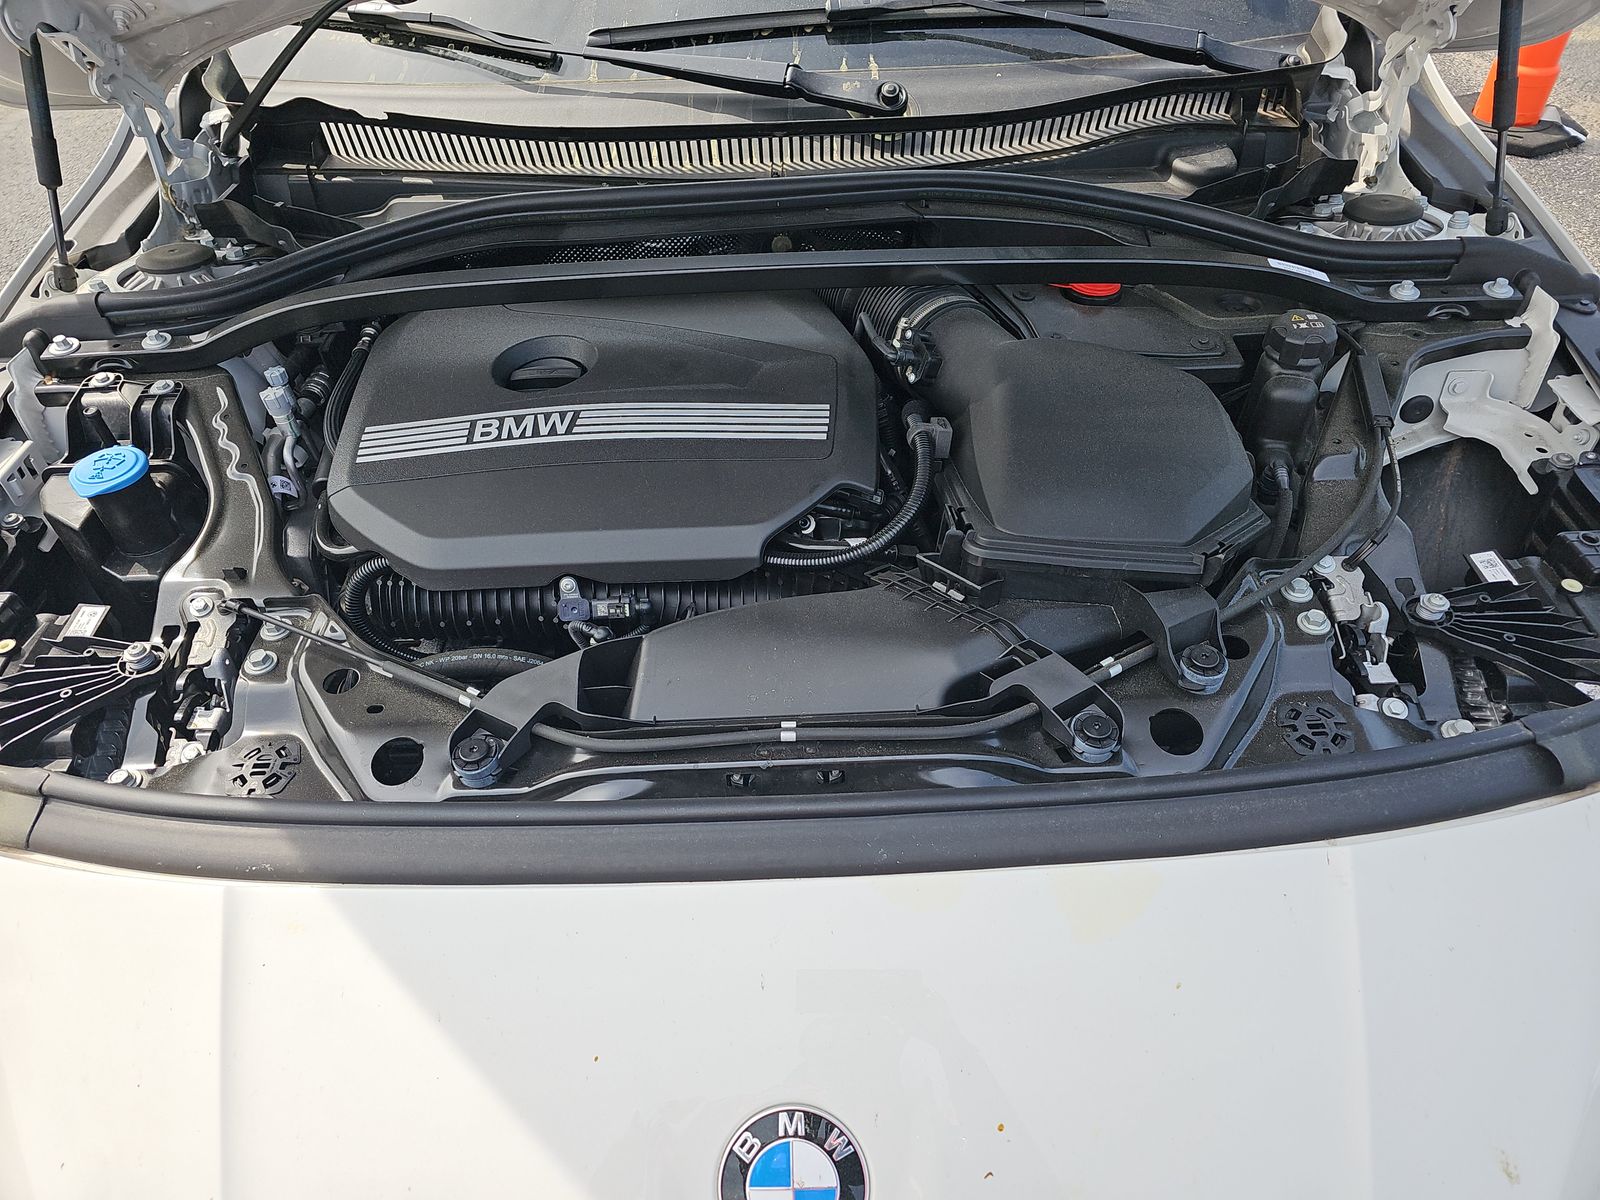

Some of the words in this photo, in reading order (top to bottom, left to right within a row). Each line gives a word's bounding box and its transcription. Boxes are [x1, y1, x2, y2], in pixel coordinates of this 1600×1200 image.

[473, 411, 574, 442] BMW
[513, 655, 526, 663] SAE
[731, 1110, 855, 1164] BMW
